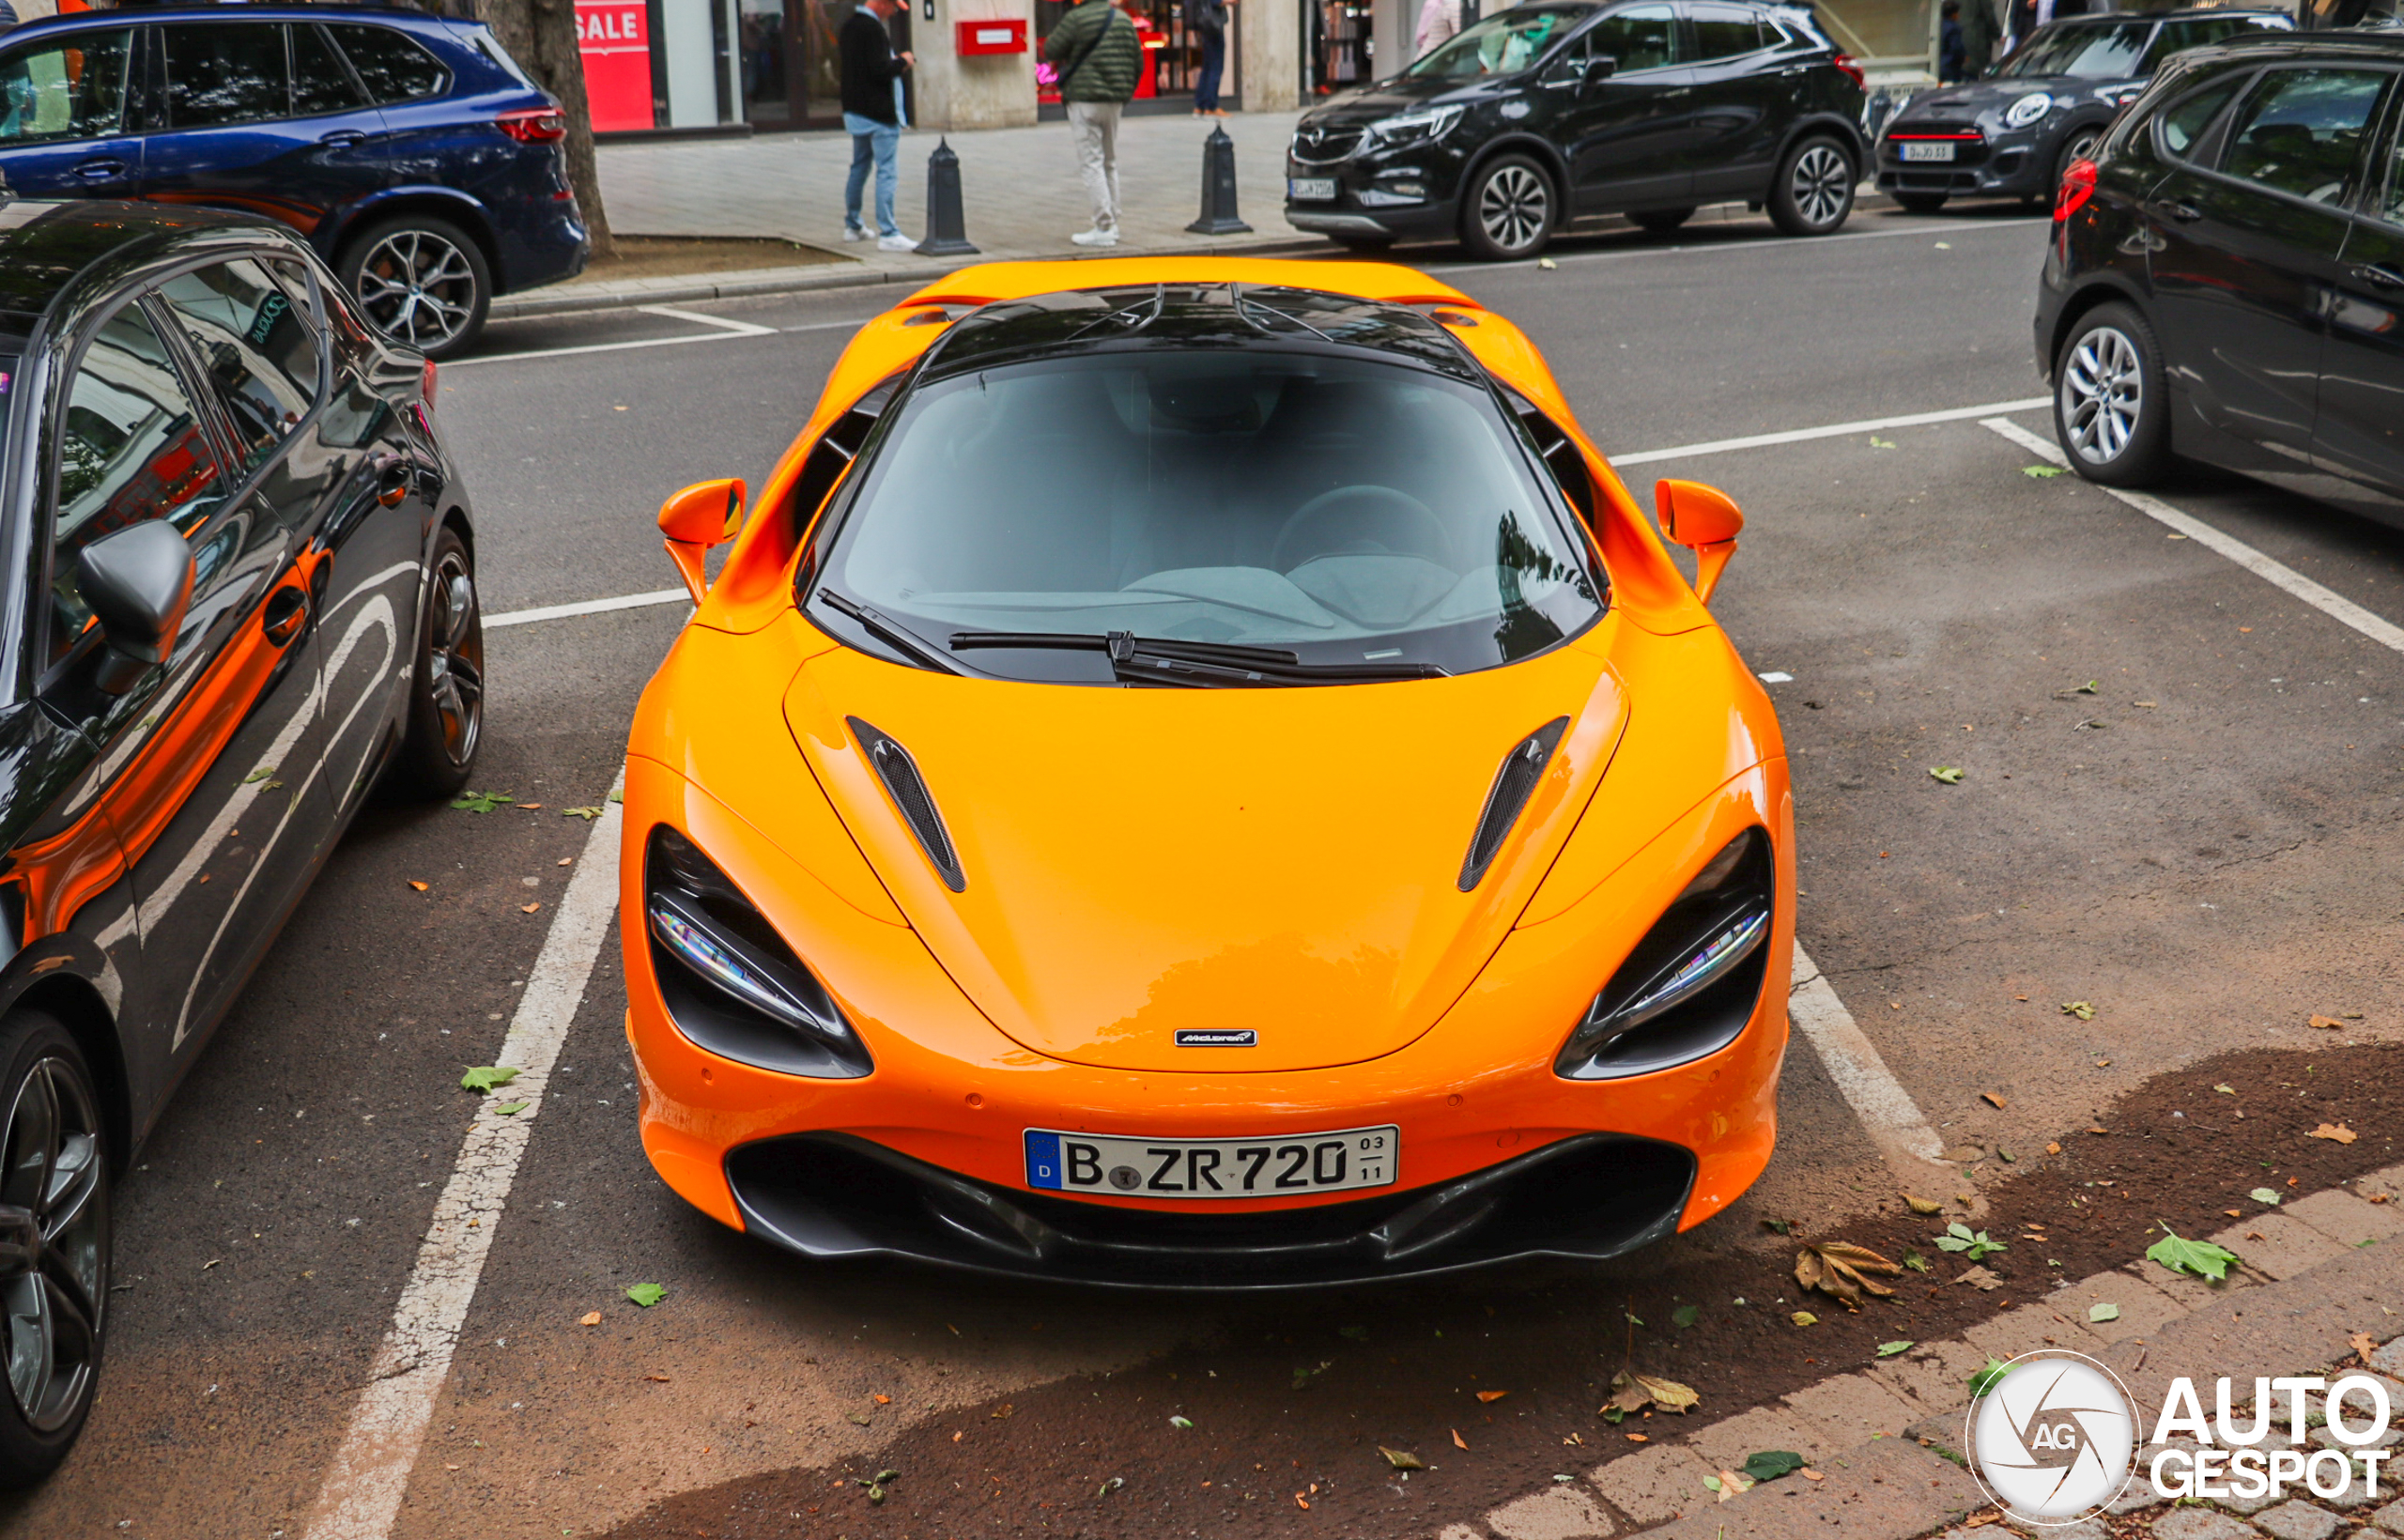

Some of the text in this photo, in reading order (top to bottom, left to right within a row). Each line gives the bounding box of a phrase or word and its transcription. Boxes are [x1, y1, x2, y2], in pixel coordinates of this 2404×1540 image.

[575, 12, 638, 39] SALE
[1360, 1136, 1383, 1150] 03
[1039, 1141, 1347, 1191] D B ZR 720
[1361, 1166, 1381, 1180] 11
